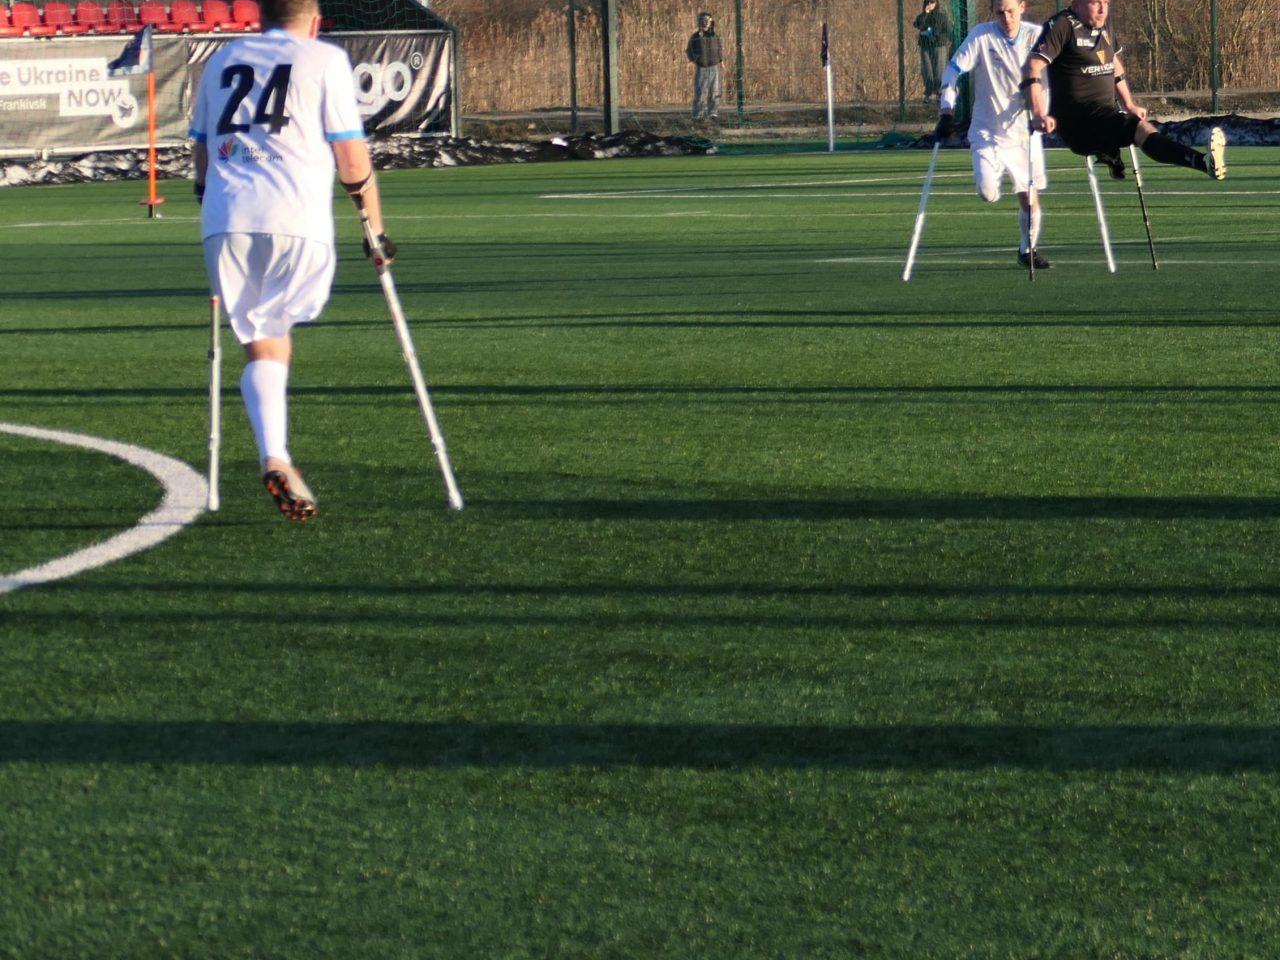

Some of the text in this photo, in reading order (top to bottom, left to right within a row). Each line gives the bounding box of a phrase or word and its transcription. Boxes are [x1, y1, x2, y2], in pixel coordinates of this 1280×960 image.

[17, 64, 101, 86] Ukraine
[67, 87, 122, 108] NOW
[216, 63, 293, 137] 24
